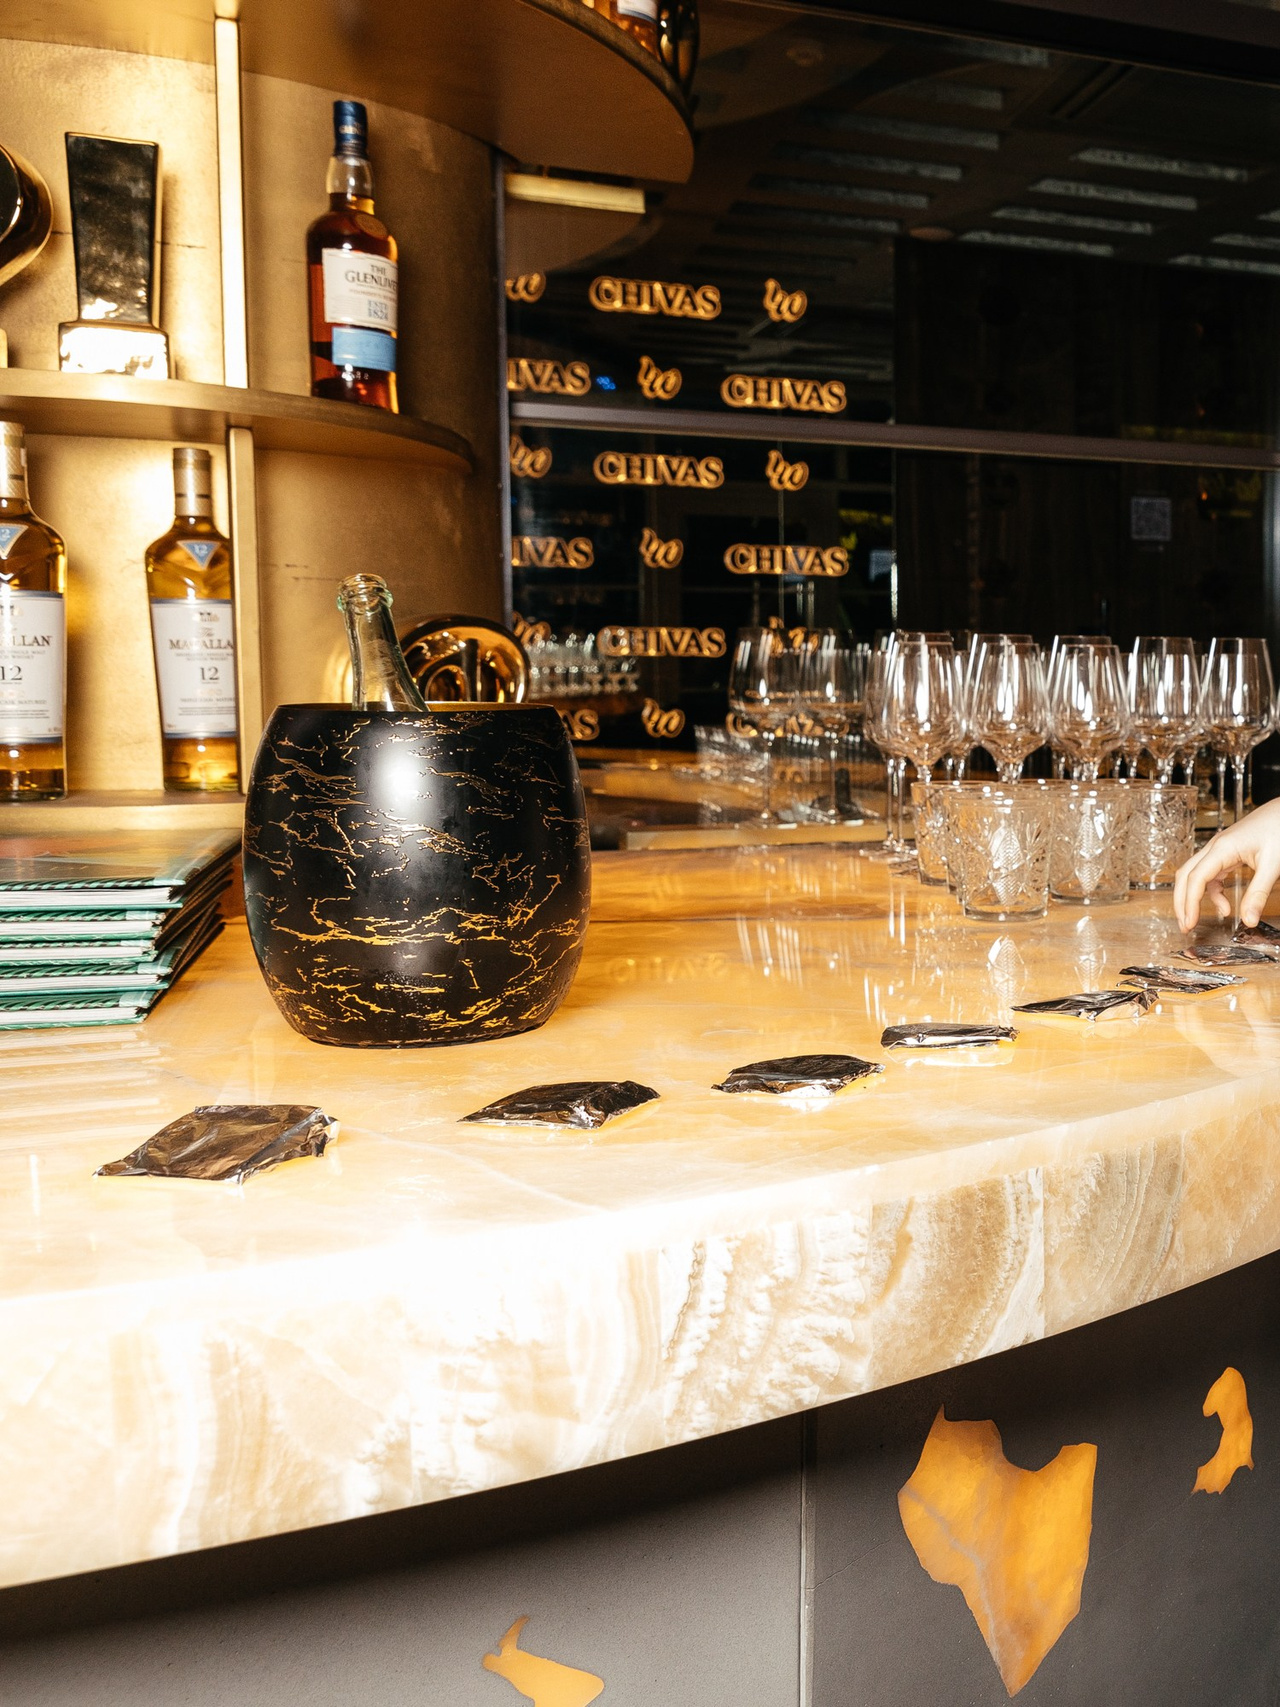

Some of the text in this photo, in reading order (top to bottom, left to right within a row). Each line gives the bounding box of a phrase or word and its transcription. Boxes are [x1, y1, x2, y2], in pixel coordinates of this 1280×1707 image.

[344, 270, 398, 292] GLENLIVE
[589, 275, 722, 320] CHIVAS
[508, 358, 591, 396] IVAS
[720, 374, 847, 413] CHIVAS
[593, 451, 725, 488] CHIVAS
[512, 535, 594, 569] IVAS
[725, 543, 850, 576] CHIVAS
[597, 626, 726, 658] CHIVAS
[0, 665, 22, 681] 12
[200, 666, 219, 681] 12
